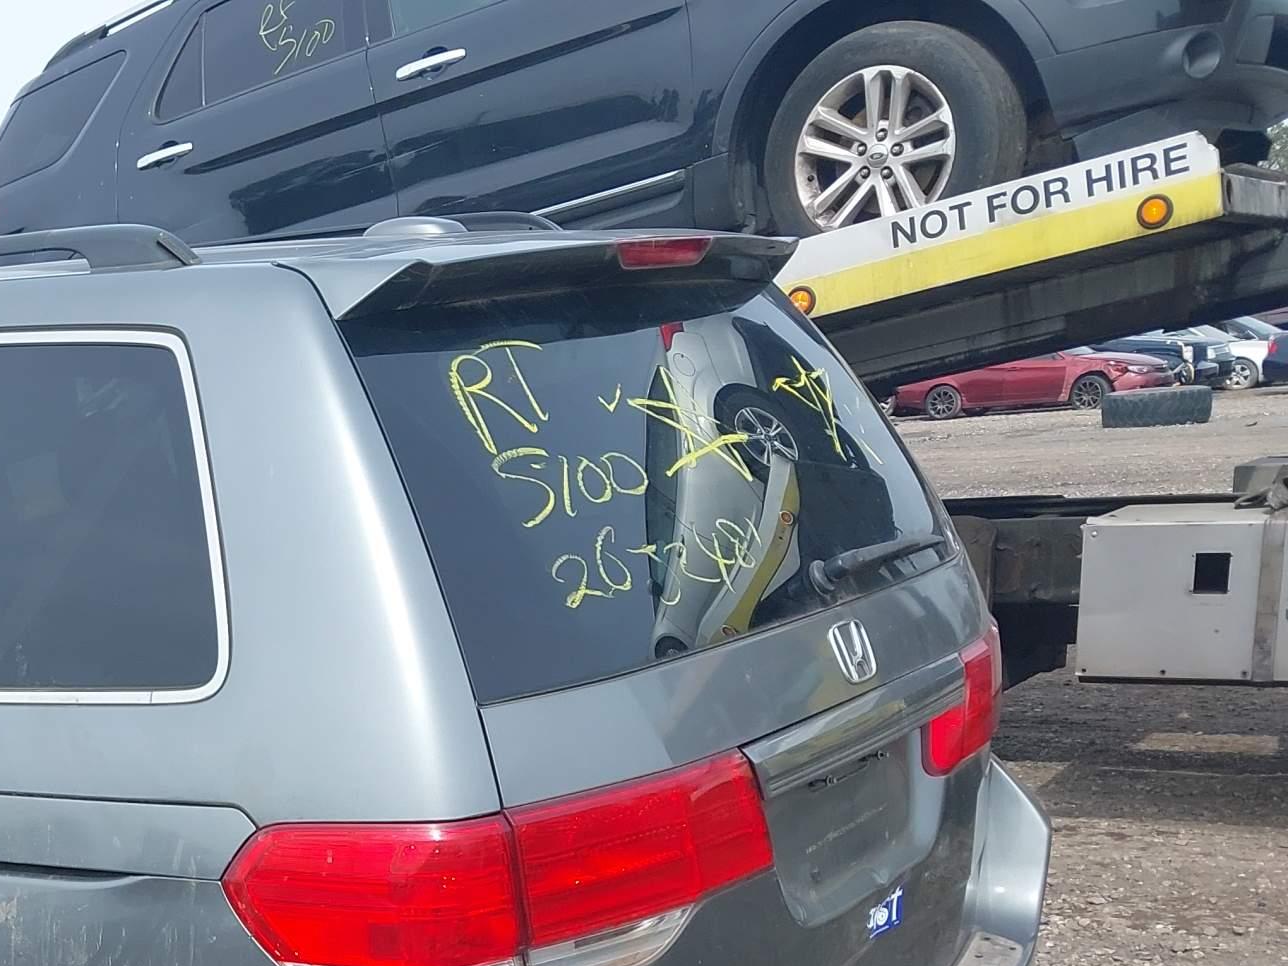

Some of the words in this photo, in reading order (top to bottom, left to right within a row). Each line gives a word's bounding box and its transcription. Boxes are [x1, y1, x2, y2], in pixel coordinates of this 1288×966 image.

[890, 201, 972, 248] NOT
[986, 176, 1070, 223] FOR
[1085, 142, 1191, 197] HIRE
[449, 339, 549, 454] RT
